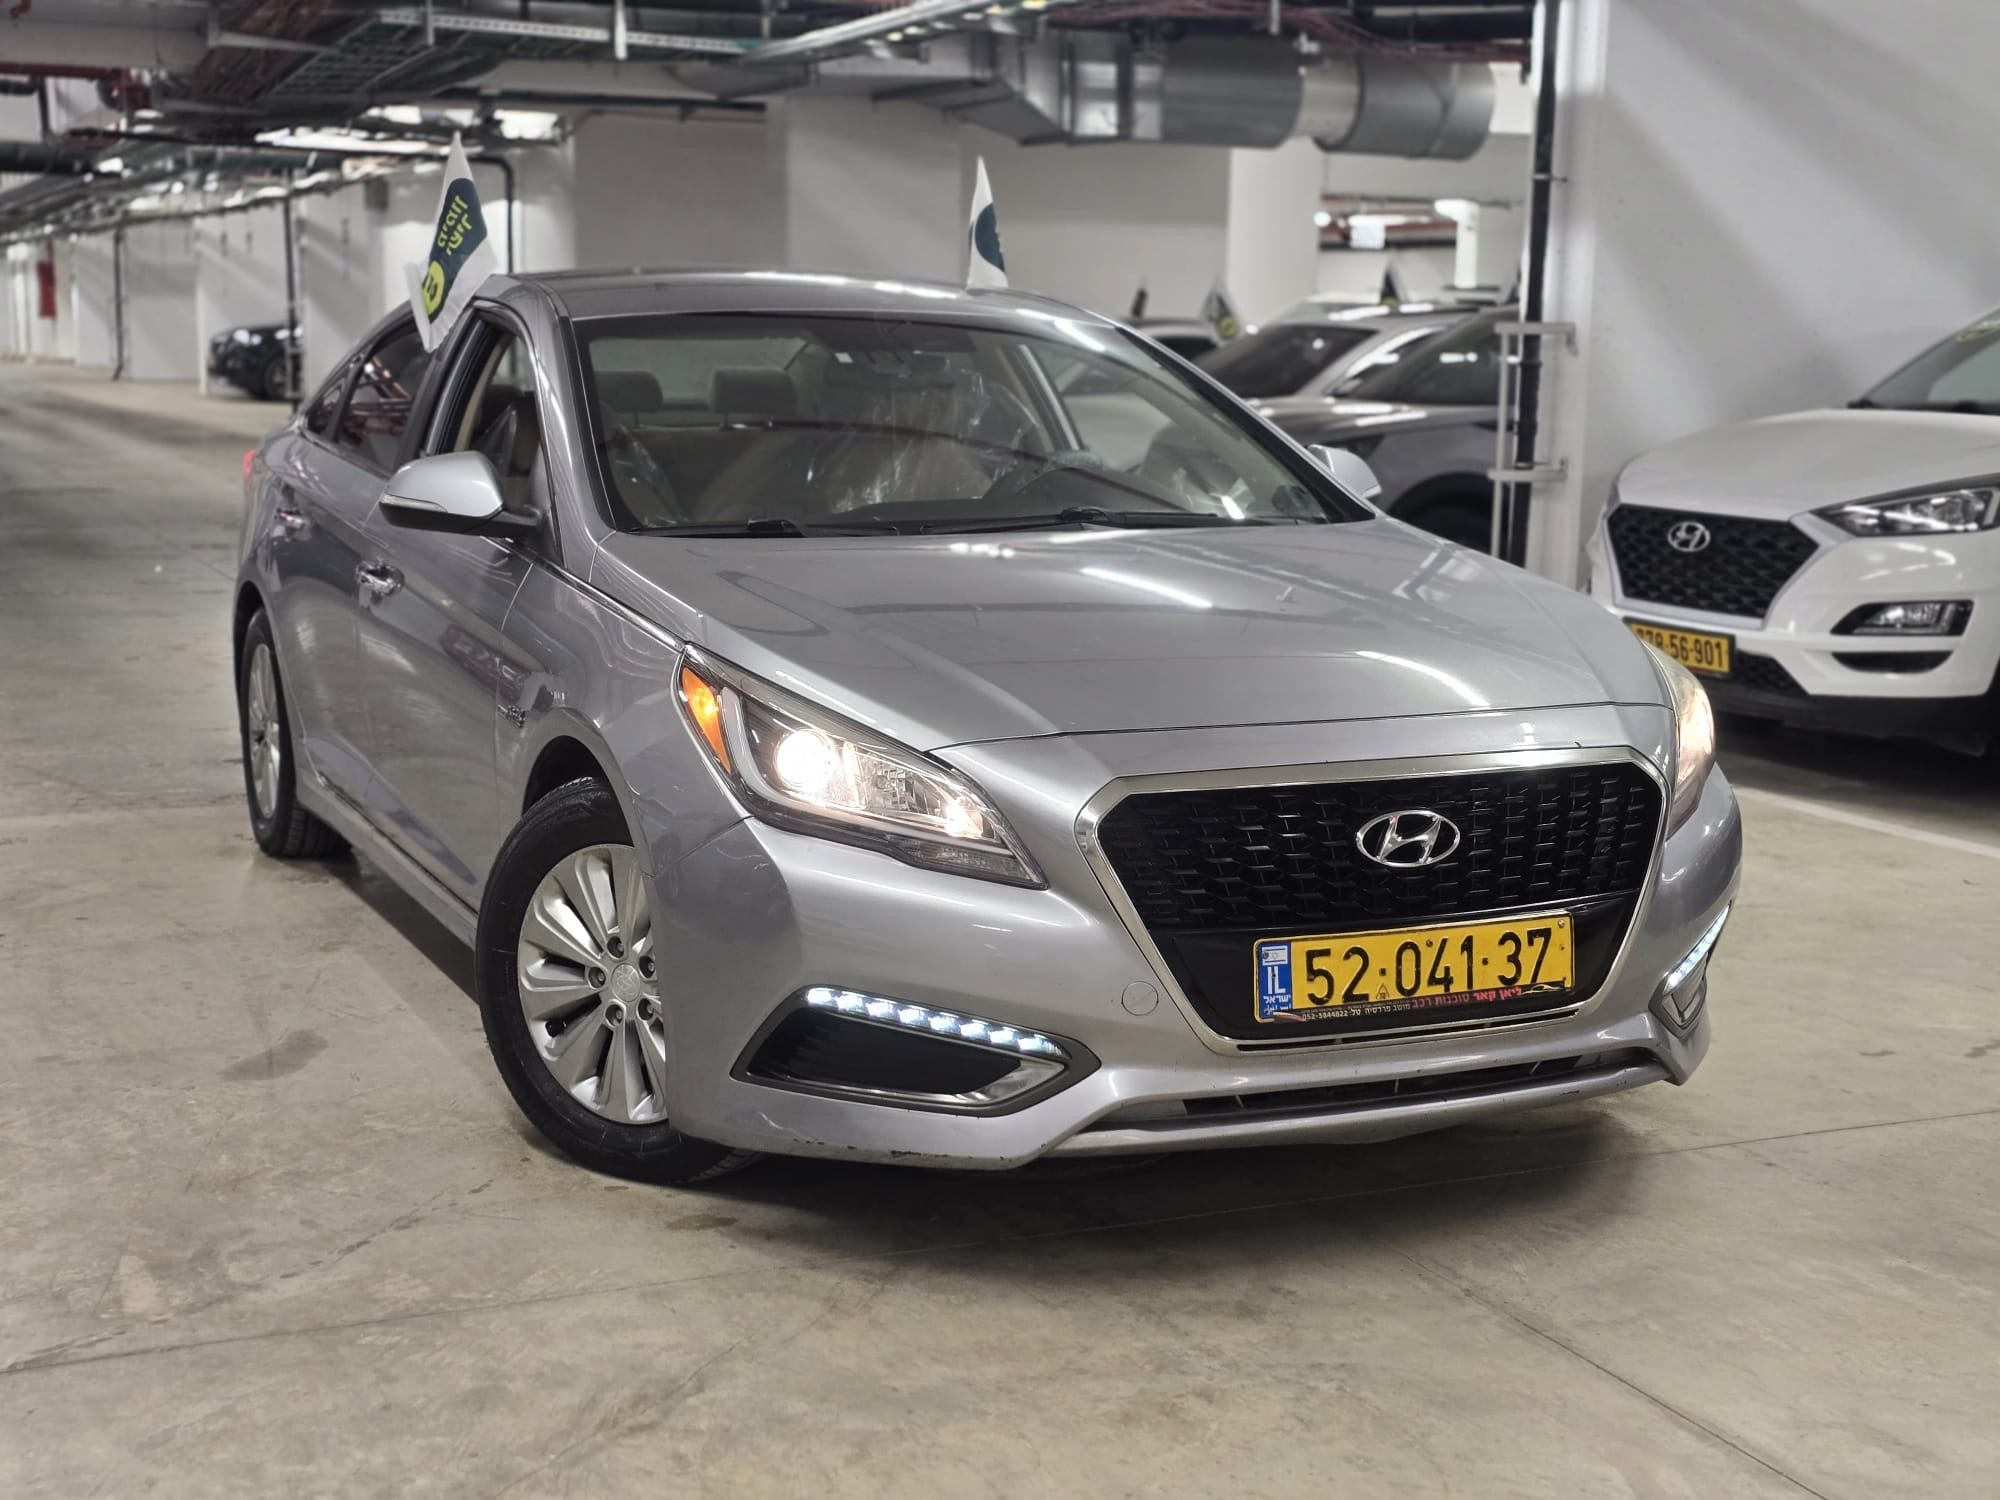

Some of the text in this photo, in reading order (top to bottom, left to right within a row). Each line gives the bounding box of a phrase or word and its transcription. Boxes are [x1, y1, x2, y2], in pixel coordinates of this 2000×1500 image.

[1267, 966, 1286, 994] IL
[1263, 994, 1292, 1004] ישראל
[1435, 993, 1470, 1006] סוכנות
[1472, 990, 1496, 1001] קאר
[1393, 1002, 1411, 1012] מושב
[1412, 998, 1431, 1008] רכב
